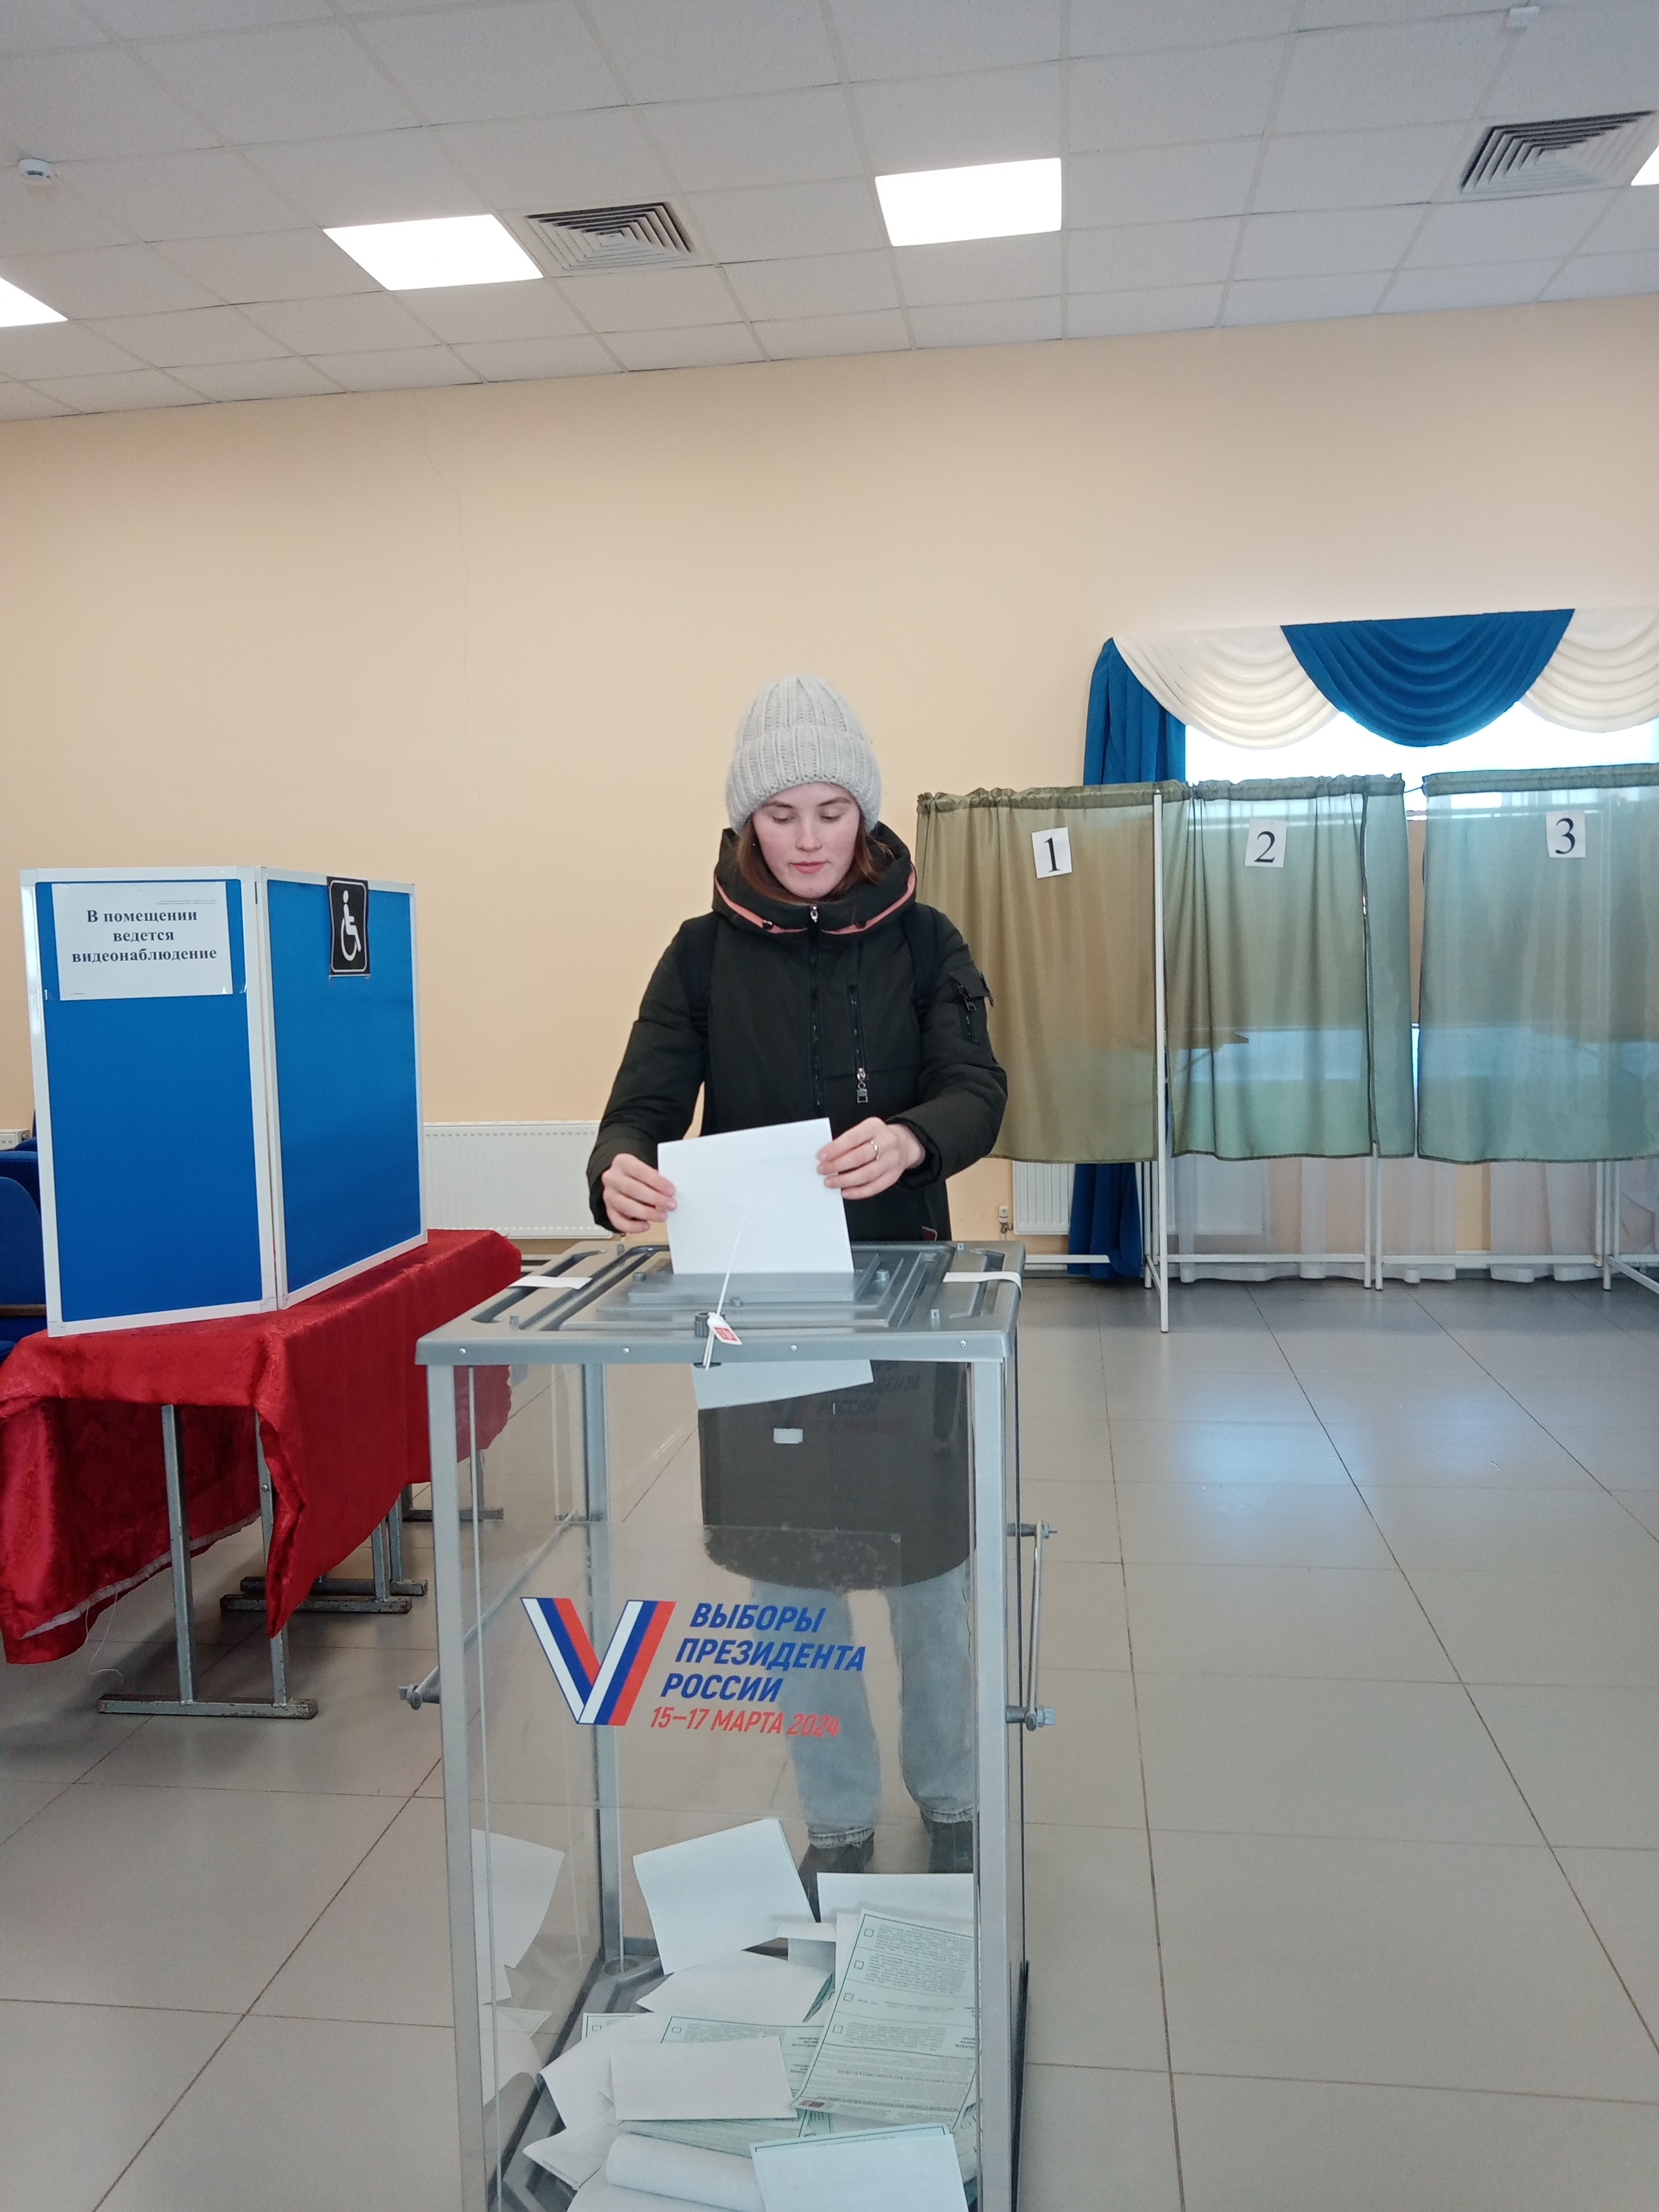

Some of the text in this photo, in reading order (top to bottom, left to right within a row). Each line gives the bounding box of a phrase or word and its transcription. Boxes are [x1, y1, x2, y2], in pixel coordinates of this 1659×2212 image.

[1254, 831, 1275, 863] 2
[1555, 818, 1576, 854] 3
[1044, 837, 1061, 873] 1
[87, 910, 197, 923] В помещении
[113, 931, 174, 942] ведется
[72, 948, 217, 963] видеонаблюдение
[689, 1603, 826, 1633] ВЫБОРЫ
[675, 1638, 866, 1672] ПРЕЗИДЕНТА
[660, 1673, 783, 1702] РОССИИ
[711, 1708, 782, 1735] МАРТА
[786, 1713, 840, 1737] 2024
